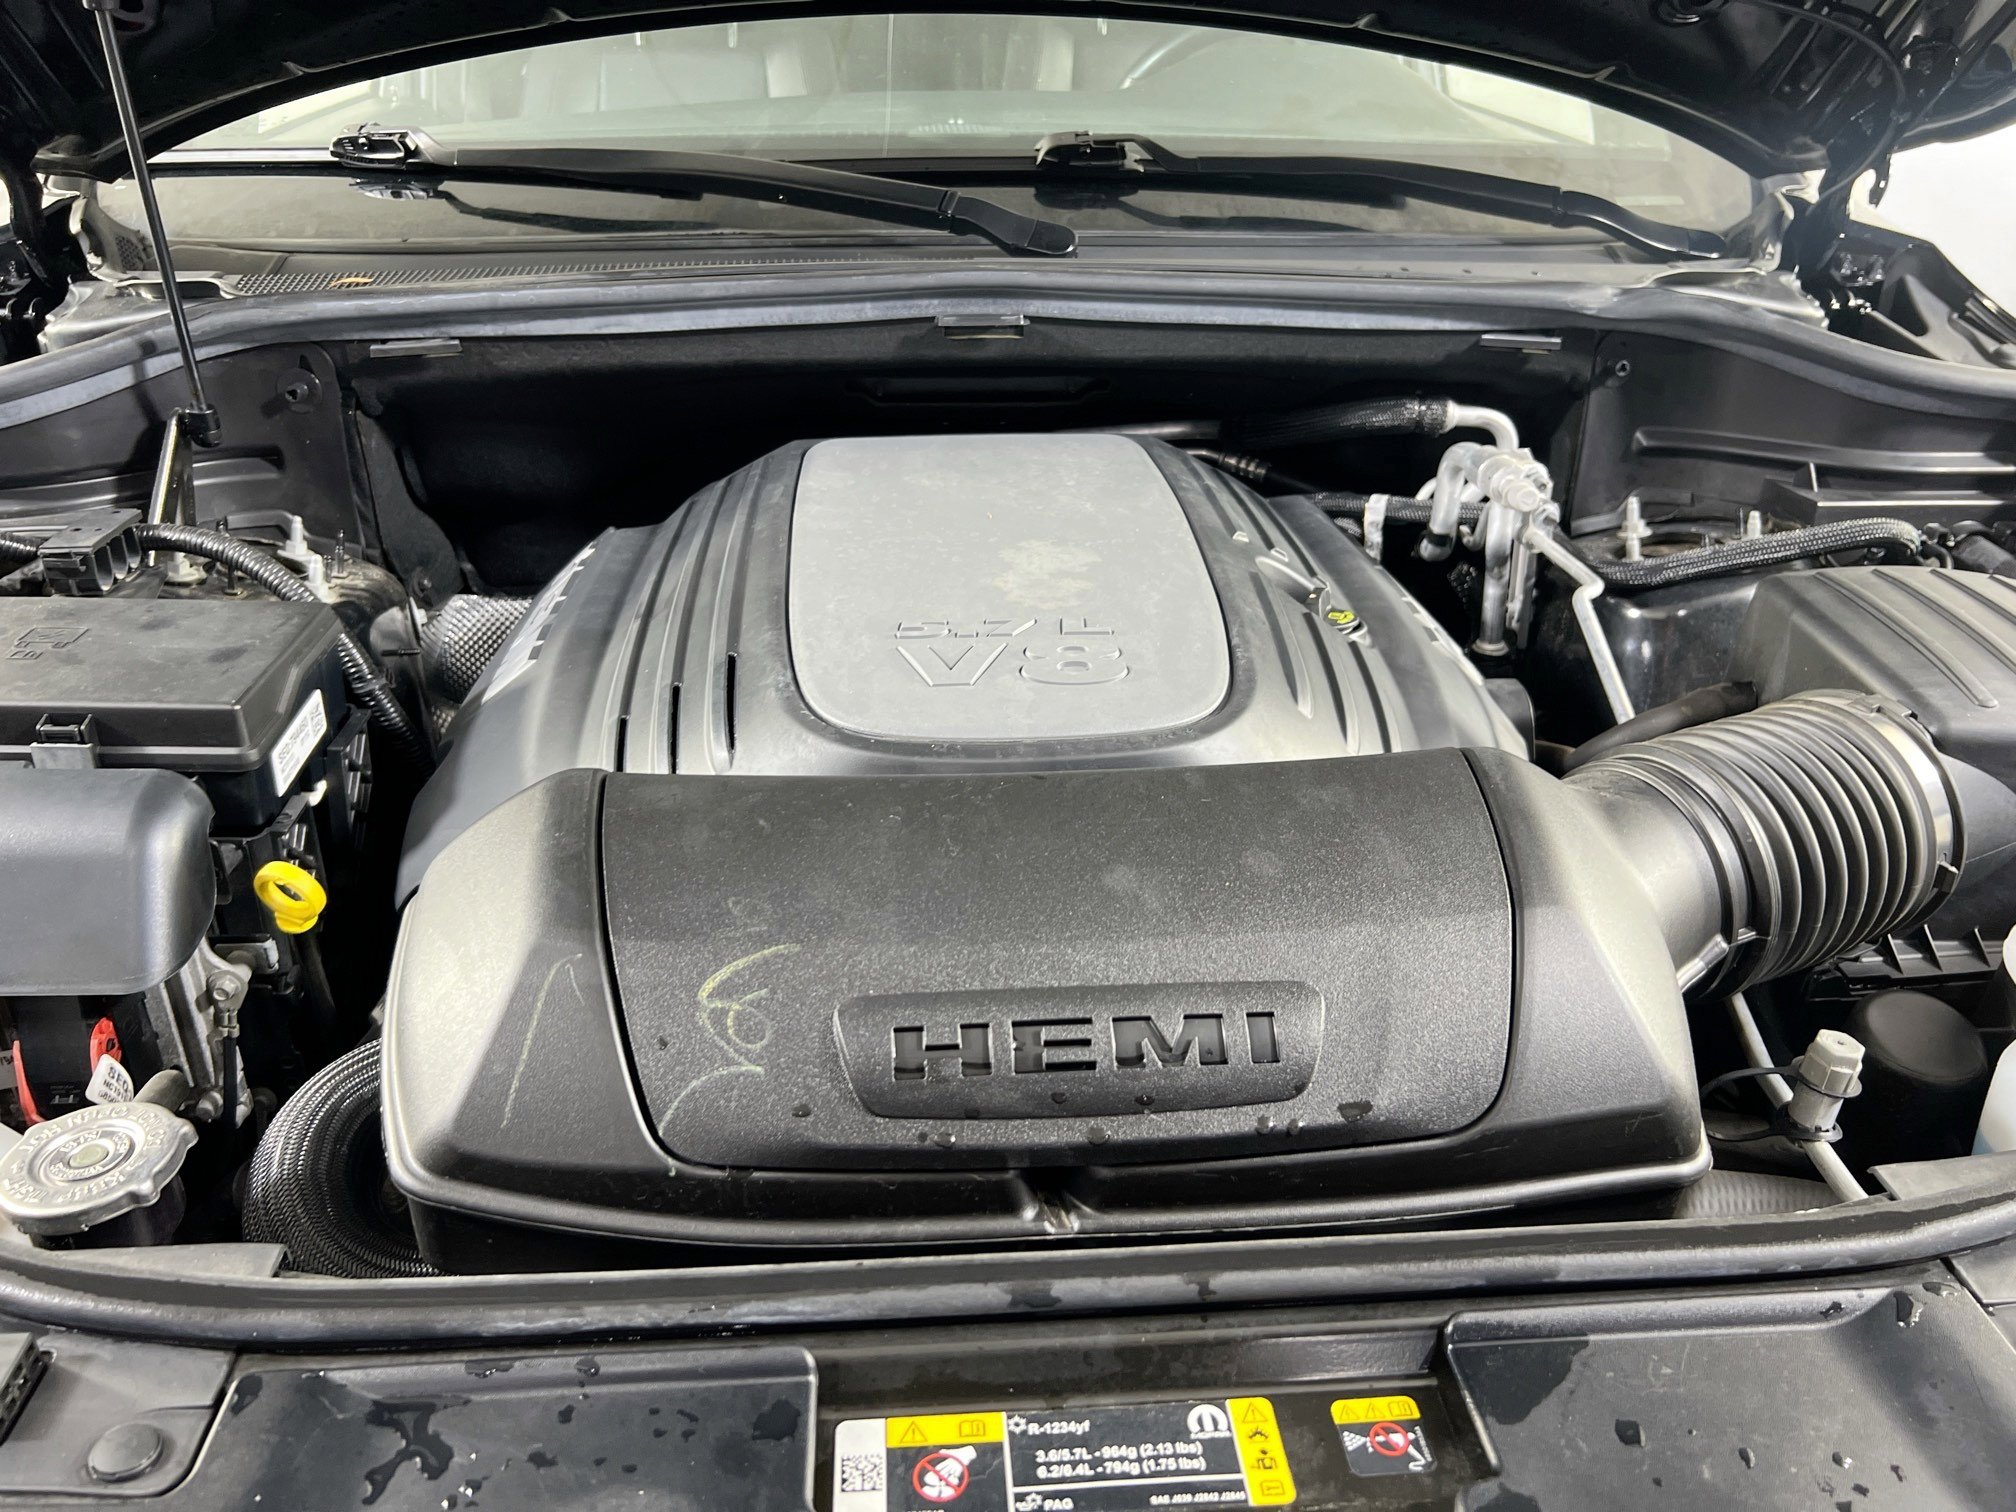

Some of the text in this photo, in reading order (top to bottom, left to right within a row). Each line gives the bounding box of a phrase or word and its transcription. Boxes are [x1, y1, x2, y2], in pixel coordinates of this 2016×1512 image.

[896, 641, 1130, 686] V8
[892, 1011, 1280, 1081] HEMI
[1027, 1419, 1091, 1436] R-1234yf
[1034, 1446, 1093, 1463] 3.6/5.7L
[1139, 1442, 1174, 1459] (2.13
[1175, 1440, 1204, 1456] lbs)
[1036, 1462, 1095, 1479] 6.2/6.4L
[1142, 1458, 1177, 1474] (1.75
[1178, 1456, 1207, 1471] lbs)
[1043, 1497, 1075, 1512] PAG
